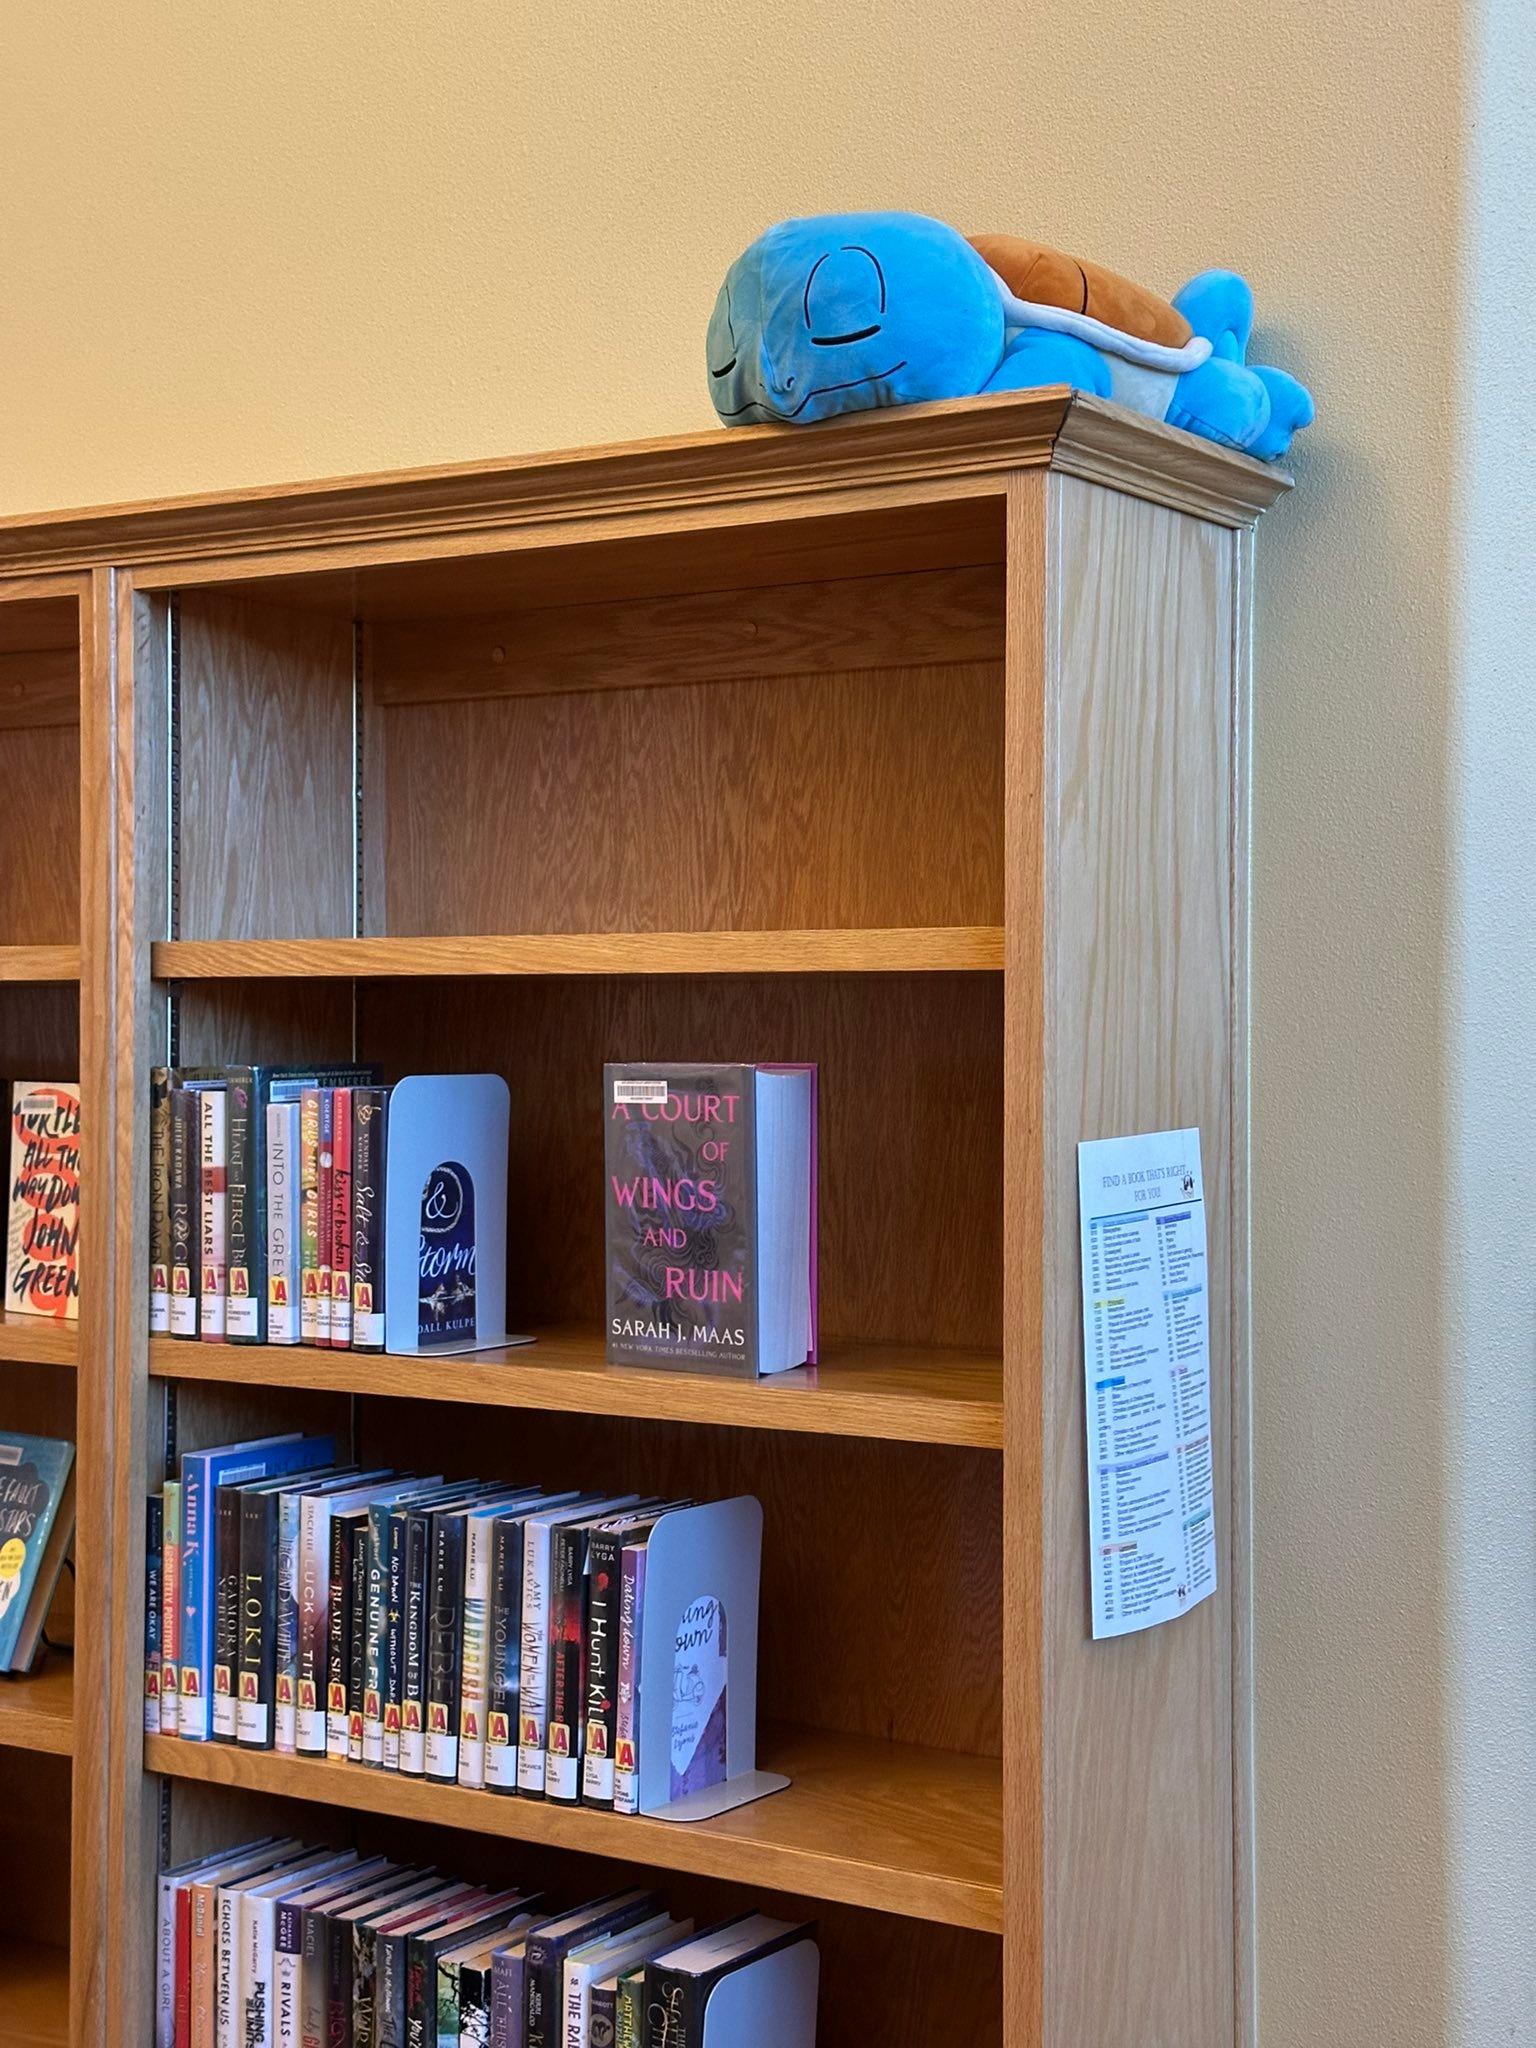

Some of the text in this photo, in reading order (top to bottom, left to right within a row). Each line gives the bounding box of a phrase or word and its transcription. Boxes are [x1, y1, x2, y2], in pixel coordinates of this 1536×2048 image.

[306, 1099, 318, 1147] GIRLS
[612, 1093, 740, 1123] A COURT
[174, 1116, 183, 1143] JULIE
[23, 1144, 53, 1171] ALL
[272, 1143, 284, 1185] INTO
[703, 1141, 730, 1162] OF
[13, 1177, 45, 1201] WAY
[152, 1163, 165, 1204] IRON
[203, 1102, 214, 1255] ALL THE BEST LIARS
[228, 1118, 247, 1243] HEART FIERCE
[611, 1175, 718, 1213] WINGS
[1128, 1171, 1145, 1184] BOOK
[1134, 1189, 1147, 1202] FOR
[272, 1193, 284, 1219] THE
[305, 1190, 318, 1238] GIRLS
[23, 1207, 79, 1256] JOHN
[272, 1228, 284, 1277] GREY
[642, 1227, 687, 1249] AND
[13, 1258, 79, 1303] GREEN
[665, 1265, 743, 1304] RUIN
[611, 1318, 746, 1346] SARAH J. MAAS
[655, 1346, 674, 1355] TIMES
[675, 1347, 718, 1359] BESTSELLING
[718, 1351, 746, 1361] AUTHOR
[591, 1541, 615, 1551] BARRY
[591, 1551, 615, 1561] LYGA
[303, 1559, 315, 1613] LUCK
[357, 1568, 365, 1601] TAYLOR
[438, 1577, 444, 1591] LU
[469, 1567, 477, 1580] LU
[498, 1577, 504, 1590] LU
[526, 1541, 535, 1609] LUKAVICS
[149, 1570, 157, 1639] WE ARE OKAY
[226, 1575, 237, 1658] GAMORA
[330, 1585, 343, 1640] BLADE
[369, 1569, 381, 1657] GENUINE
[389, 1556, 399, 1674] NO DAWN WITHOUT
[532, 1581, 541, 1610] AMY
[244, 1574, 262, 1665] LOKI
[352, 1607, 363, 1667] BLACK
[407, 1591, 421, 1667] KINGDOM
[493, 1617, 508, 1686] YOUNG
[521, 1622, 541, 1676] WOMEN
[555, 1652, 565, 1713] AFTER THE
[251, 1942, 259, 1974] McGarry
[305, 1918, 315, 1958] MACIEL
[161, 1919, 171, 2012] ABOUT A GIRL
[220, 1899, 231, 2025] ECHOES BETWEEN US
[254, 1981, 265, 2043] PUSHING
[280, 1982, 291, 2036] RIVALS
[568, 1992, 582, 2019] THE
